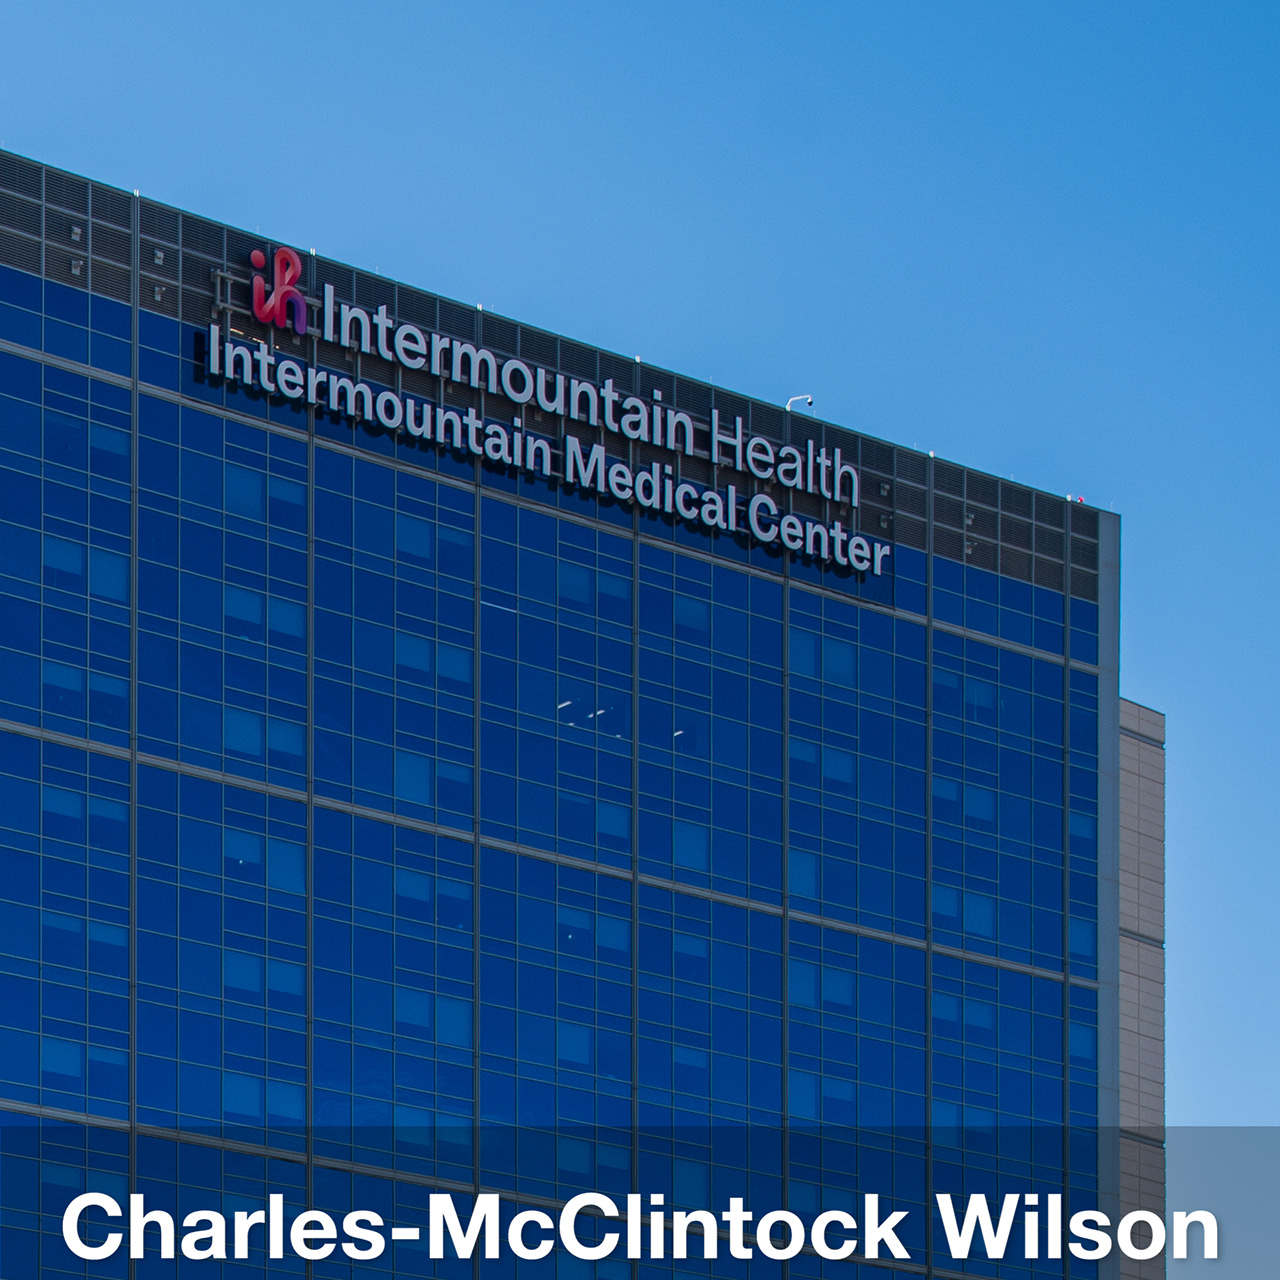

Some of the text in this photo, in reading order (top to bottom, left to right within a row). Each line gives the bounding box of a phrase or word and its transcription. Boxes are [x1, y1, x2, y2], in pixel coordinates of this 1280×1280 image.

[207, 324, 891, 576] Intermountain Medical Center
[323, 282, 859, 508] Intermountain Health
